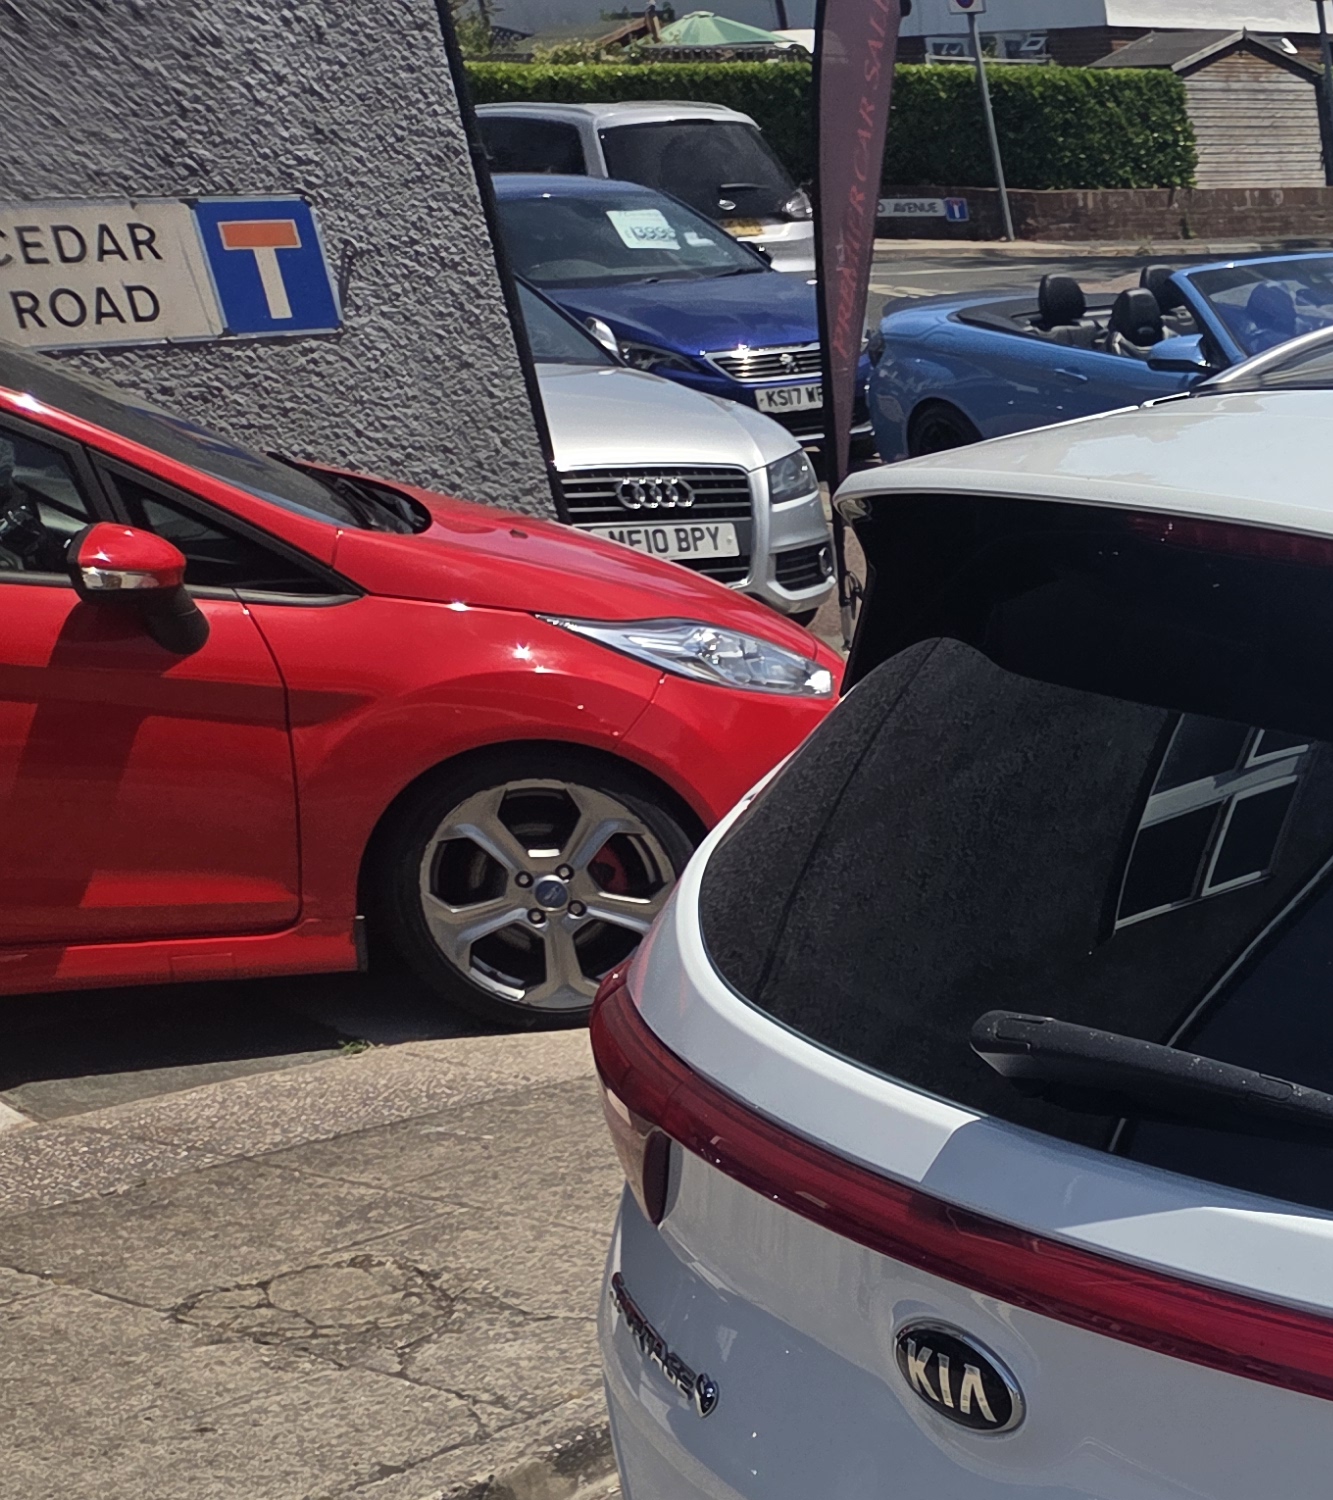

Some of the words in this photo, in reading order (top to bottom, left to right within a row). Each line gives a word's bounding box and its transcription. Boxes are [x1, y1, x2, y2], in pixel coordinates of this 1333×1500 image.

[854, 96, 876, 182] CAR
[893, 202, 938, 213] AVENUE
[9, 284, 160, 329] ROAD
[765, 387, 801, 408] KS17
[674, 526, 719, 553] BPY
[906, 1337, 998, 1423] KIA
